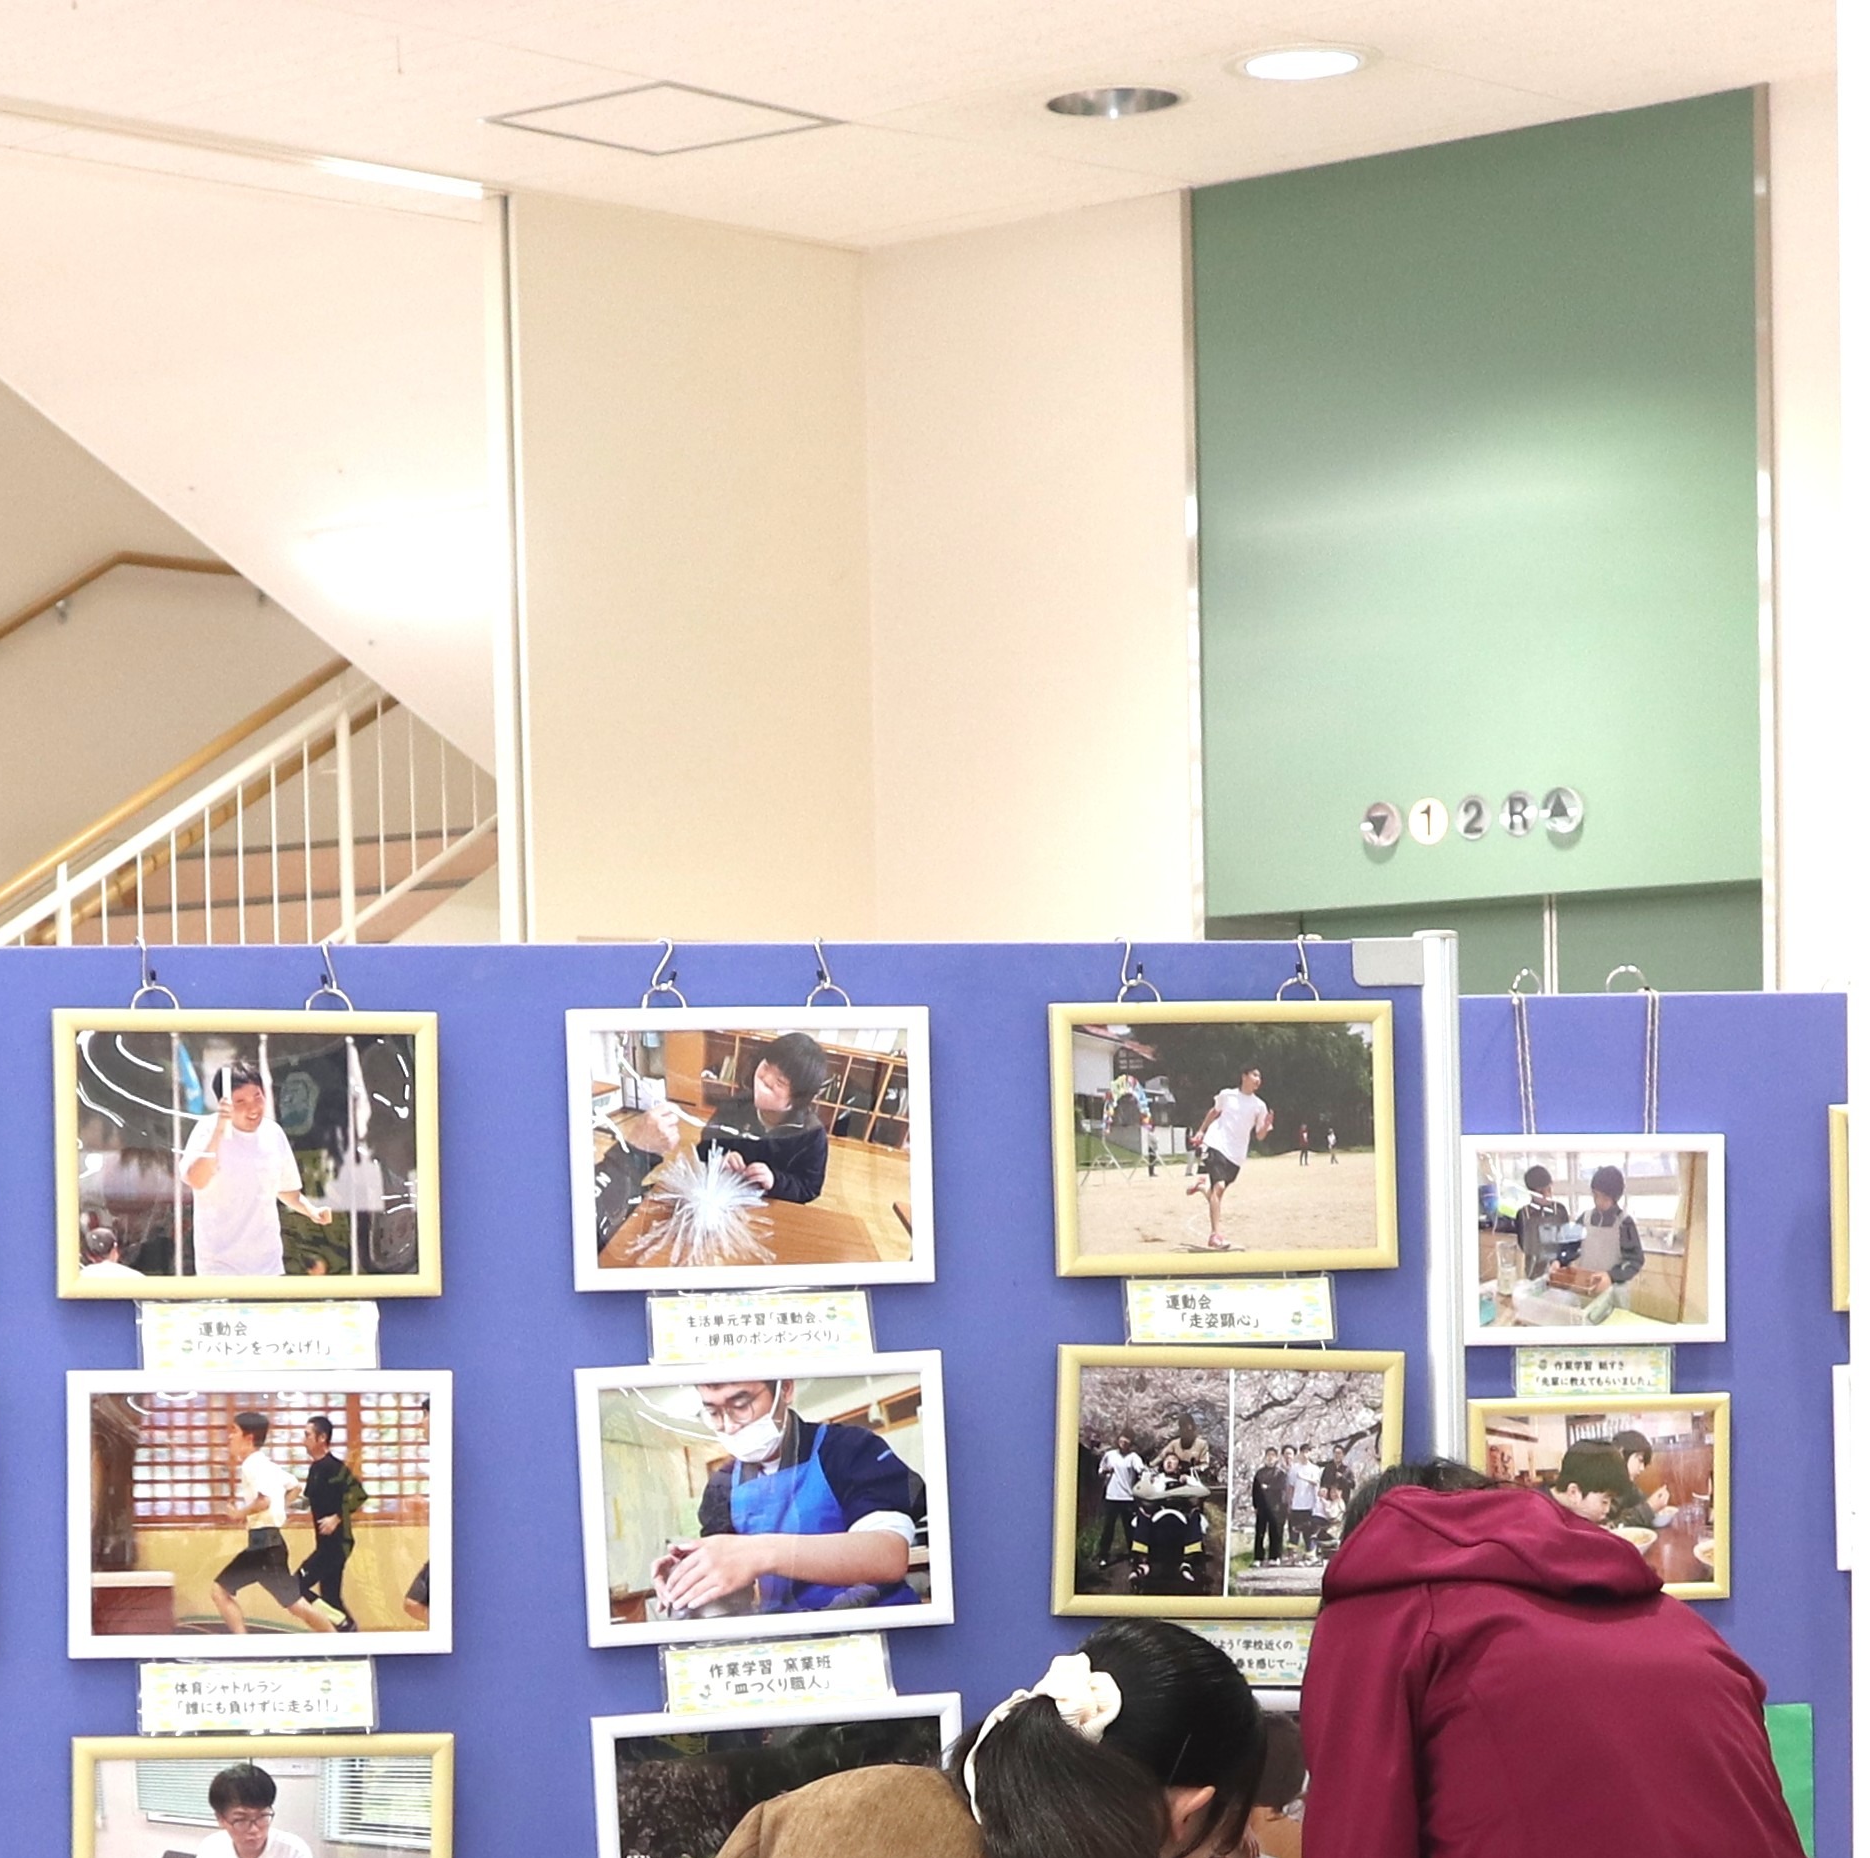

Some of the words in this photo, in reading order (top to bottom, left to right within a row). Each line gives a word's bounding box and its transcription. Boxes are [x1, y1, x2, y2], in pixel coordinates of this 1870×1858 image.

[1420, 804, 1432, 836] 1
[1463, 800, 1483, 834] 2
[1509, 797, 1529, 830] R
[1166, 1294, 1211, 1310] 運動会
[198, 1321, 249, 1337] 運動会
[709, 1659, 774, 1680] 作業学習
[783, 1655, 833, 1674] 窯業班
[174, 1680, 282, 1696] 体育シャトルラン
[725, 1675, 831, 1695] 「皿つくり職人」
